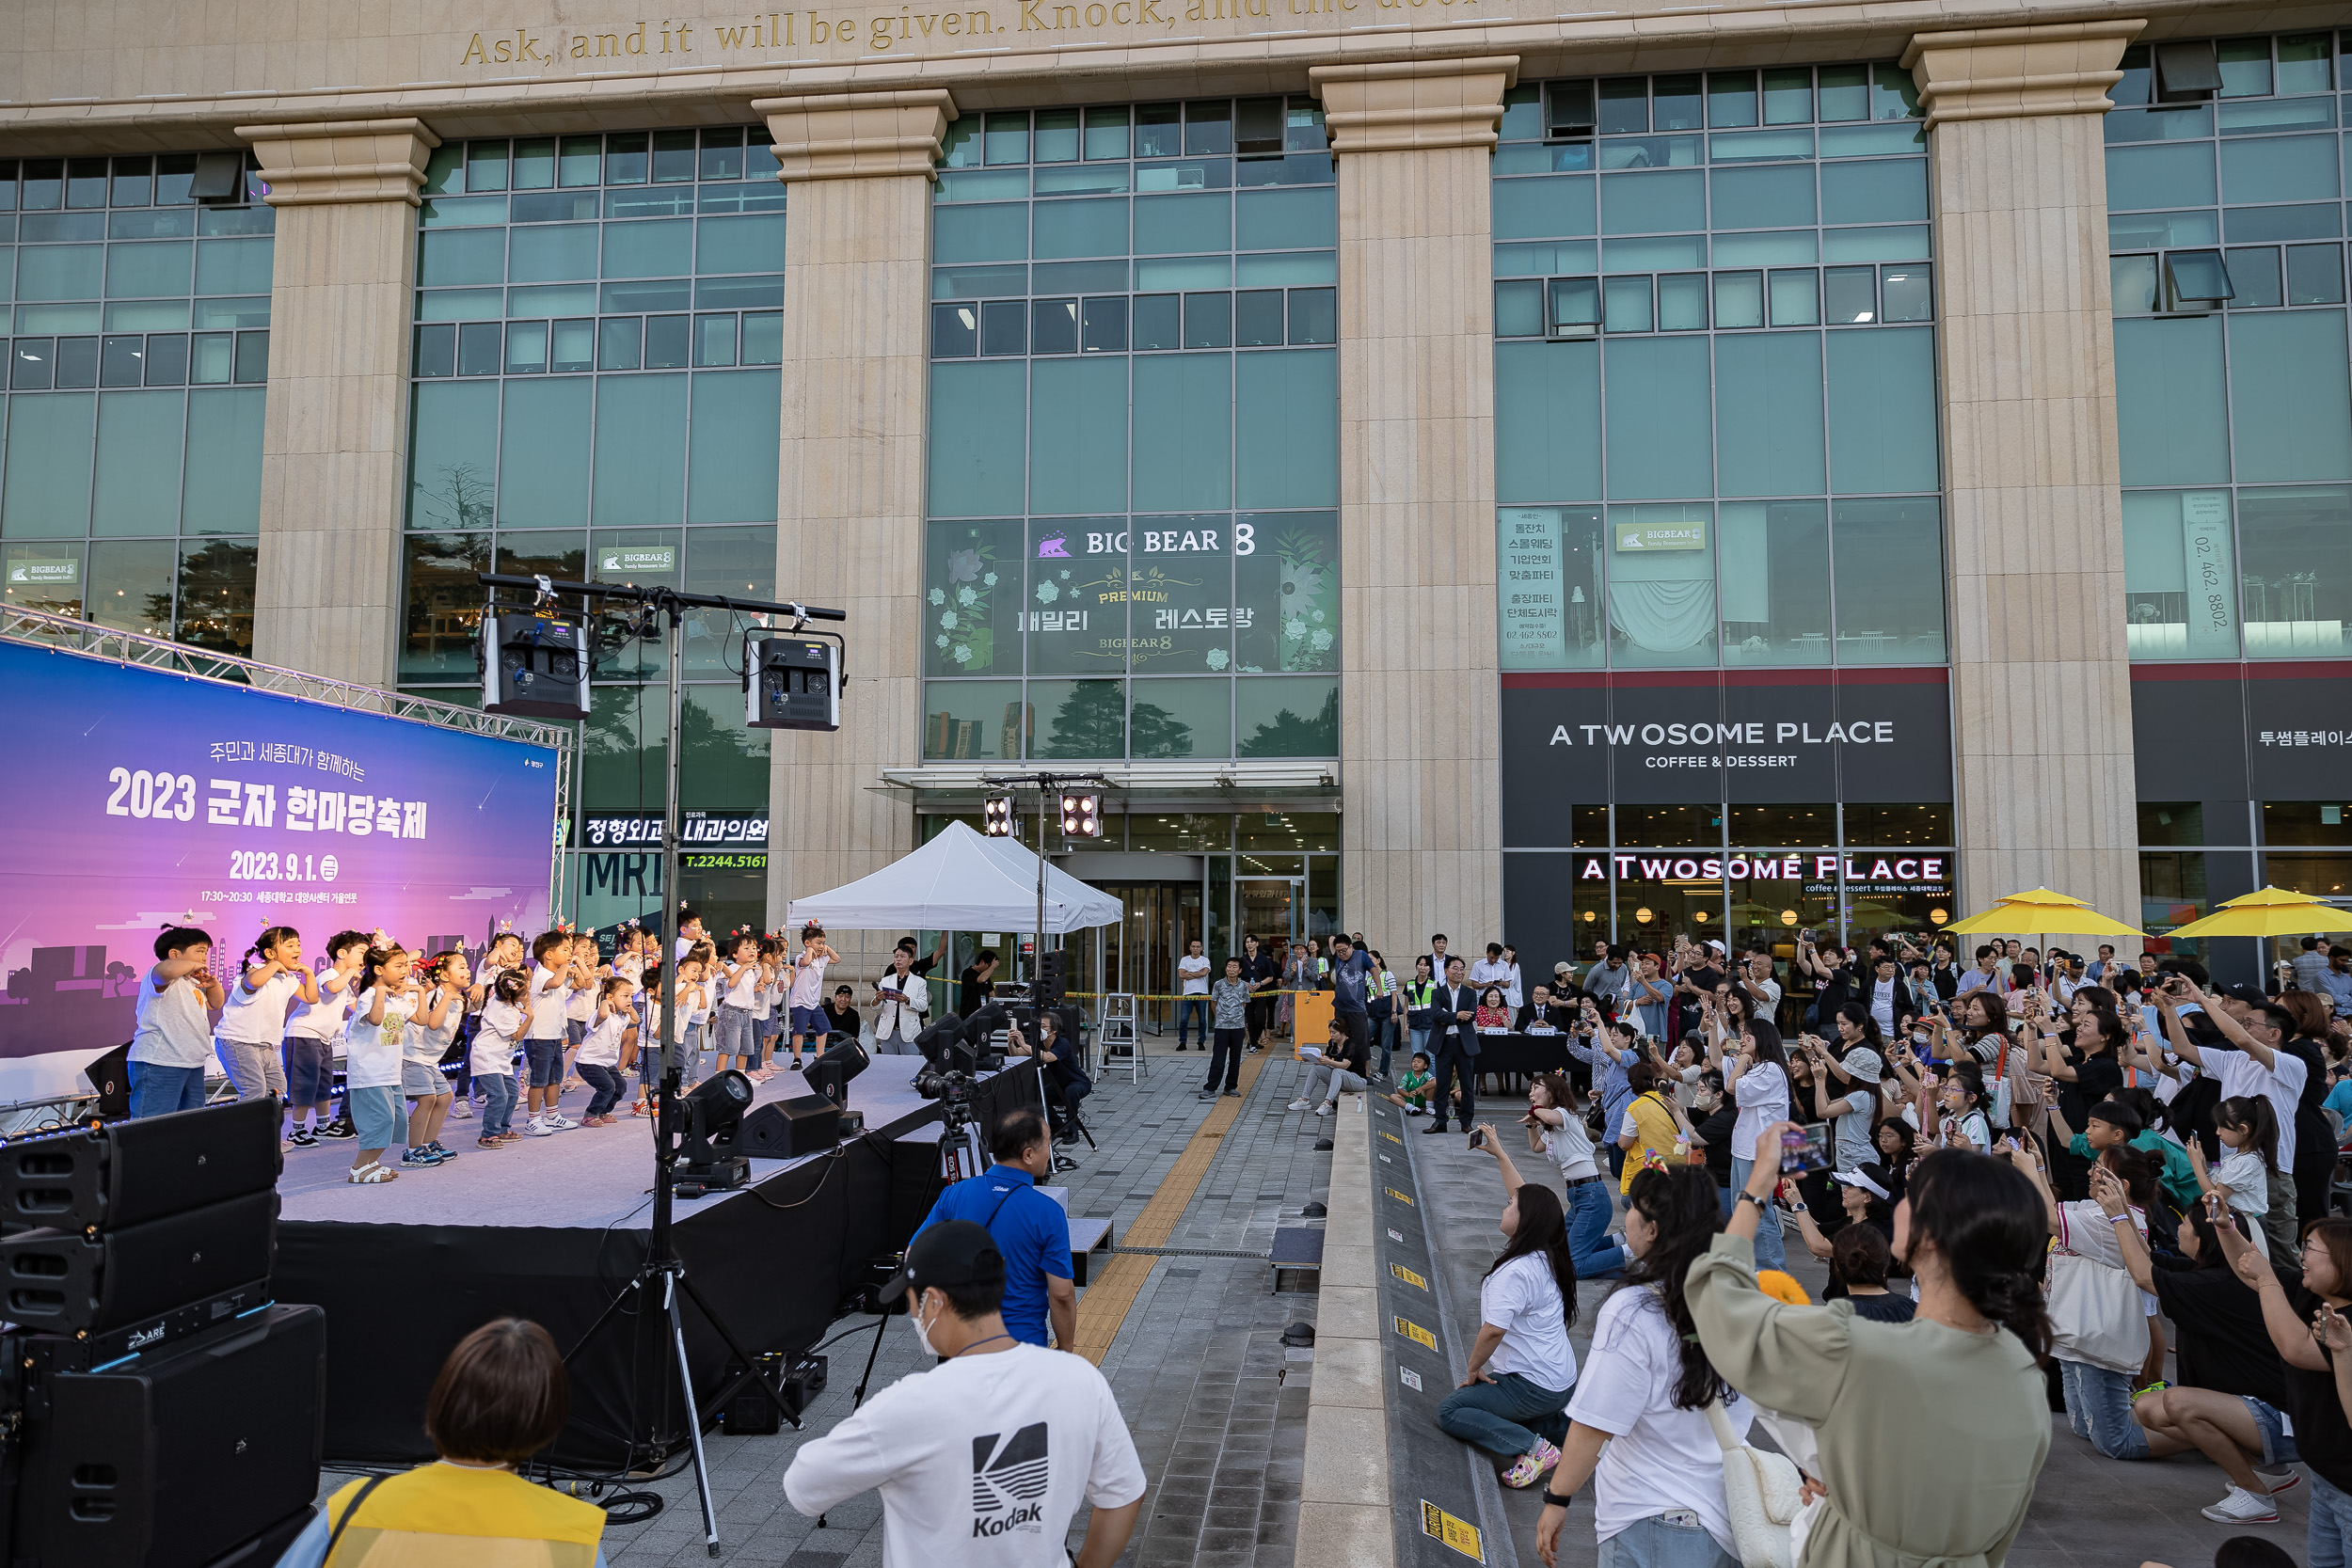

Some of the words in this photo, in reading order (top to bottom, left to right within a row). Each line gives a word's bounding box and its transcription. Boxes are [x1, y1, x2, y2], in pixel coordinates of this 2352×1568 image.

[460, 29, 553, 68] Ask,
[570, 22, 648, 58] and
[660, 20, 693, 55] it
[714, 13, 797, 51] will
[807, 10, 857, 45] be
[869, 6, 1007, 52] given.
[1018, 0, 1177, 31] Knock,
[1515, 524, 1545, 534] 돌잔치
[1087, 531, 1135, 554] BIG
[1144, 530, 1220, 552] BEAR
[1508, 538, 1553, 549] 스몰웨딩
[1510, 555, 1551, 564] 기업연회
[1509, 570, 1553, 580] 맞춤파티
[1098, 590, 1168, 605] PREMIUM
[1511, 594, 1552, 604] 출장파티
[1155, 607, 1255, 630] 레스토랑
[1507, 608, 1558, 618] 단체도시락
[1506, 630, 1558, 640] 02.462.8802
[1549, 724, 1573, 746] A
[1776, 721, 1895, 744] PLACE
[210, 740, 256, 764] 주민과
[258, 742, 314, 768] 세종대가
[317, 750, 366, 783] 함께하는
[1645, 756, 1708, 768] COFFEE
[1711, 756, 1723, 768] &
[1726, 755, 1798, 768] DESSERT
[105, 767, 198, 822] 2023
[207, 779, 277, 828] 군자
[285, 784, 428, 840] 한마당축제
[684, 818, 770, 843] 내과의원
[686, 855, 767, 868] T.2244.5161
[1581, 858, 1606, 880] A
[1613, 854, 1804, 880] TWOSOME
[1815, 853, 1944, 880] PLACE
[1805, 884, 1832, 893] coffee
[1844, 884, 1871, 893] essert
[200, 890, 253, 903] 17:30~20:30
[256, 891, 294, 905] 세종대학교
[294, 891, 330, 905] 대양AI센터
[947, 1155, 956, 1172] EOS
[972, 1502, 1043, 1538] Kodak
